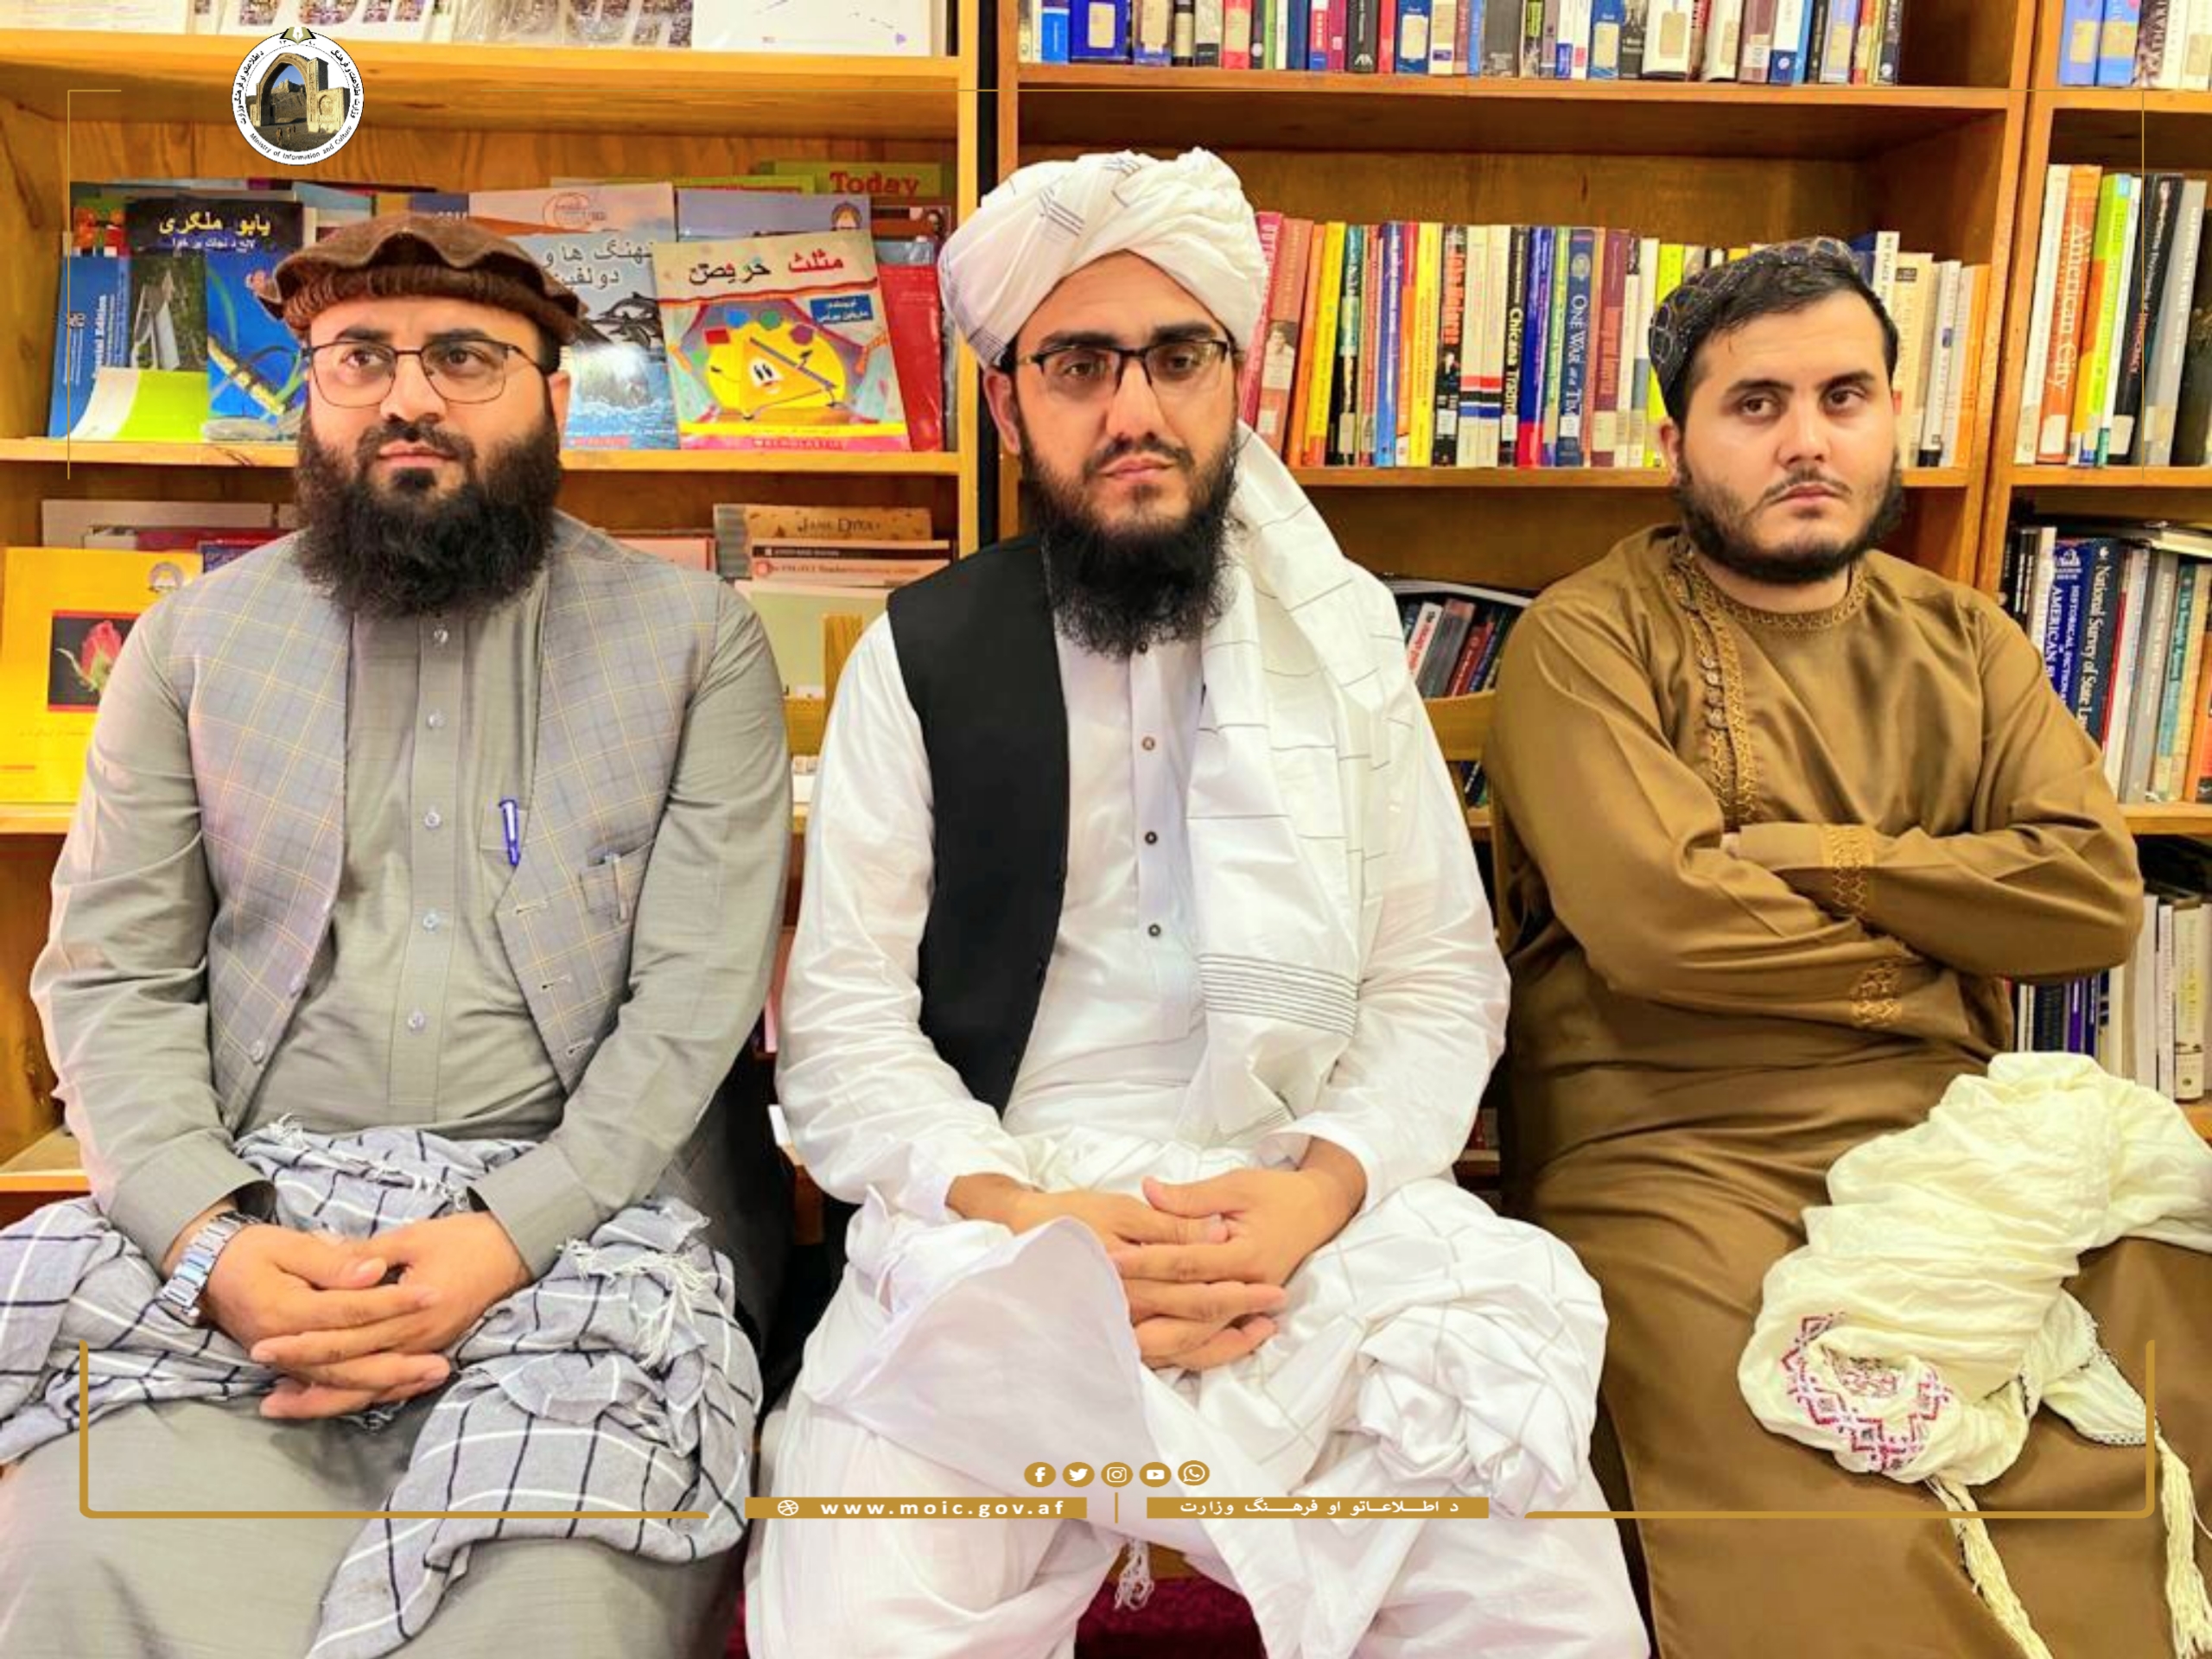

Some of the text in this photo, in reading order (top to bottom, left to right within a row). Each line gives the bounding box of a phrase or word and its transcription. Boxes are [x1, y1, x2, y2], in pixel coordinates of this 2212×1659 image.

[830, 170, 919, 198] Today
[788, 249, 843, 274] مثلث
[1570, 295, 1589, 329] ONE
[2047, 225, 2088, 389] American City
[1506, 308, 1523, 366] Chicana
[1568, 330, 1586, 365] WAR
[1565, 389, 1582, 416] TIM
[2090, 565, 2112, 617] National
[2044, 586, 2063, 663] AMERICAN
[2081, 617, 2104, 659] Survey
[2082, 661, 2098, 675] of
[2078, 676, 2097, 705] State
